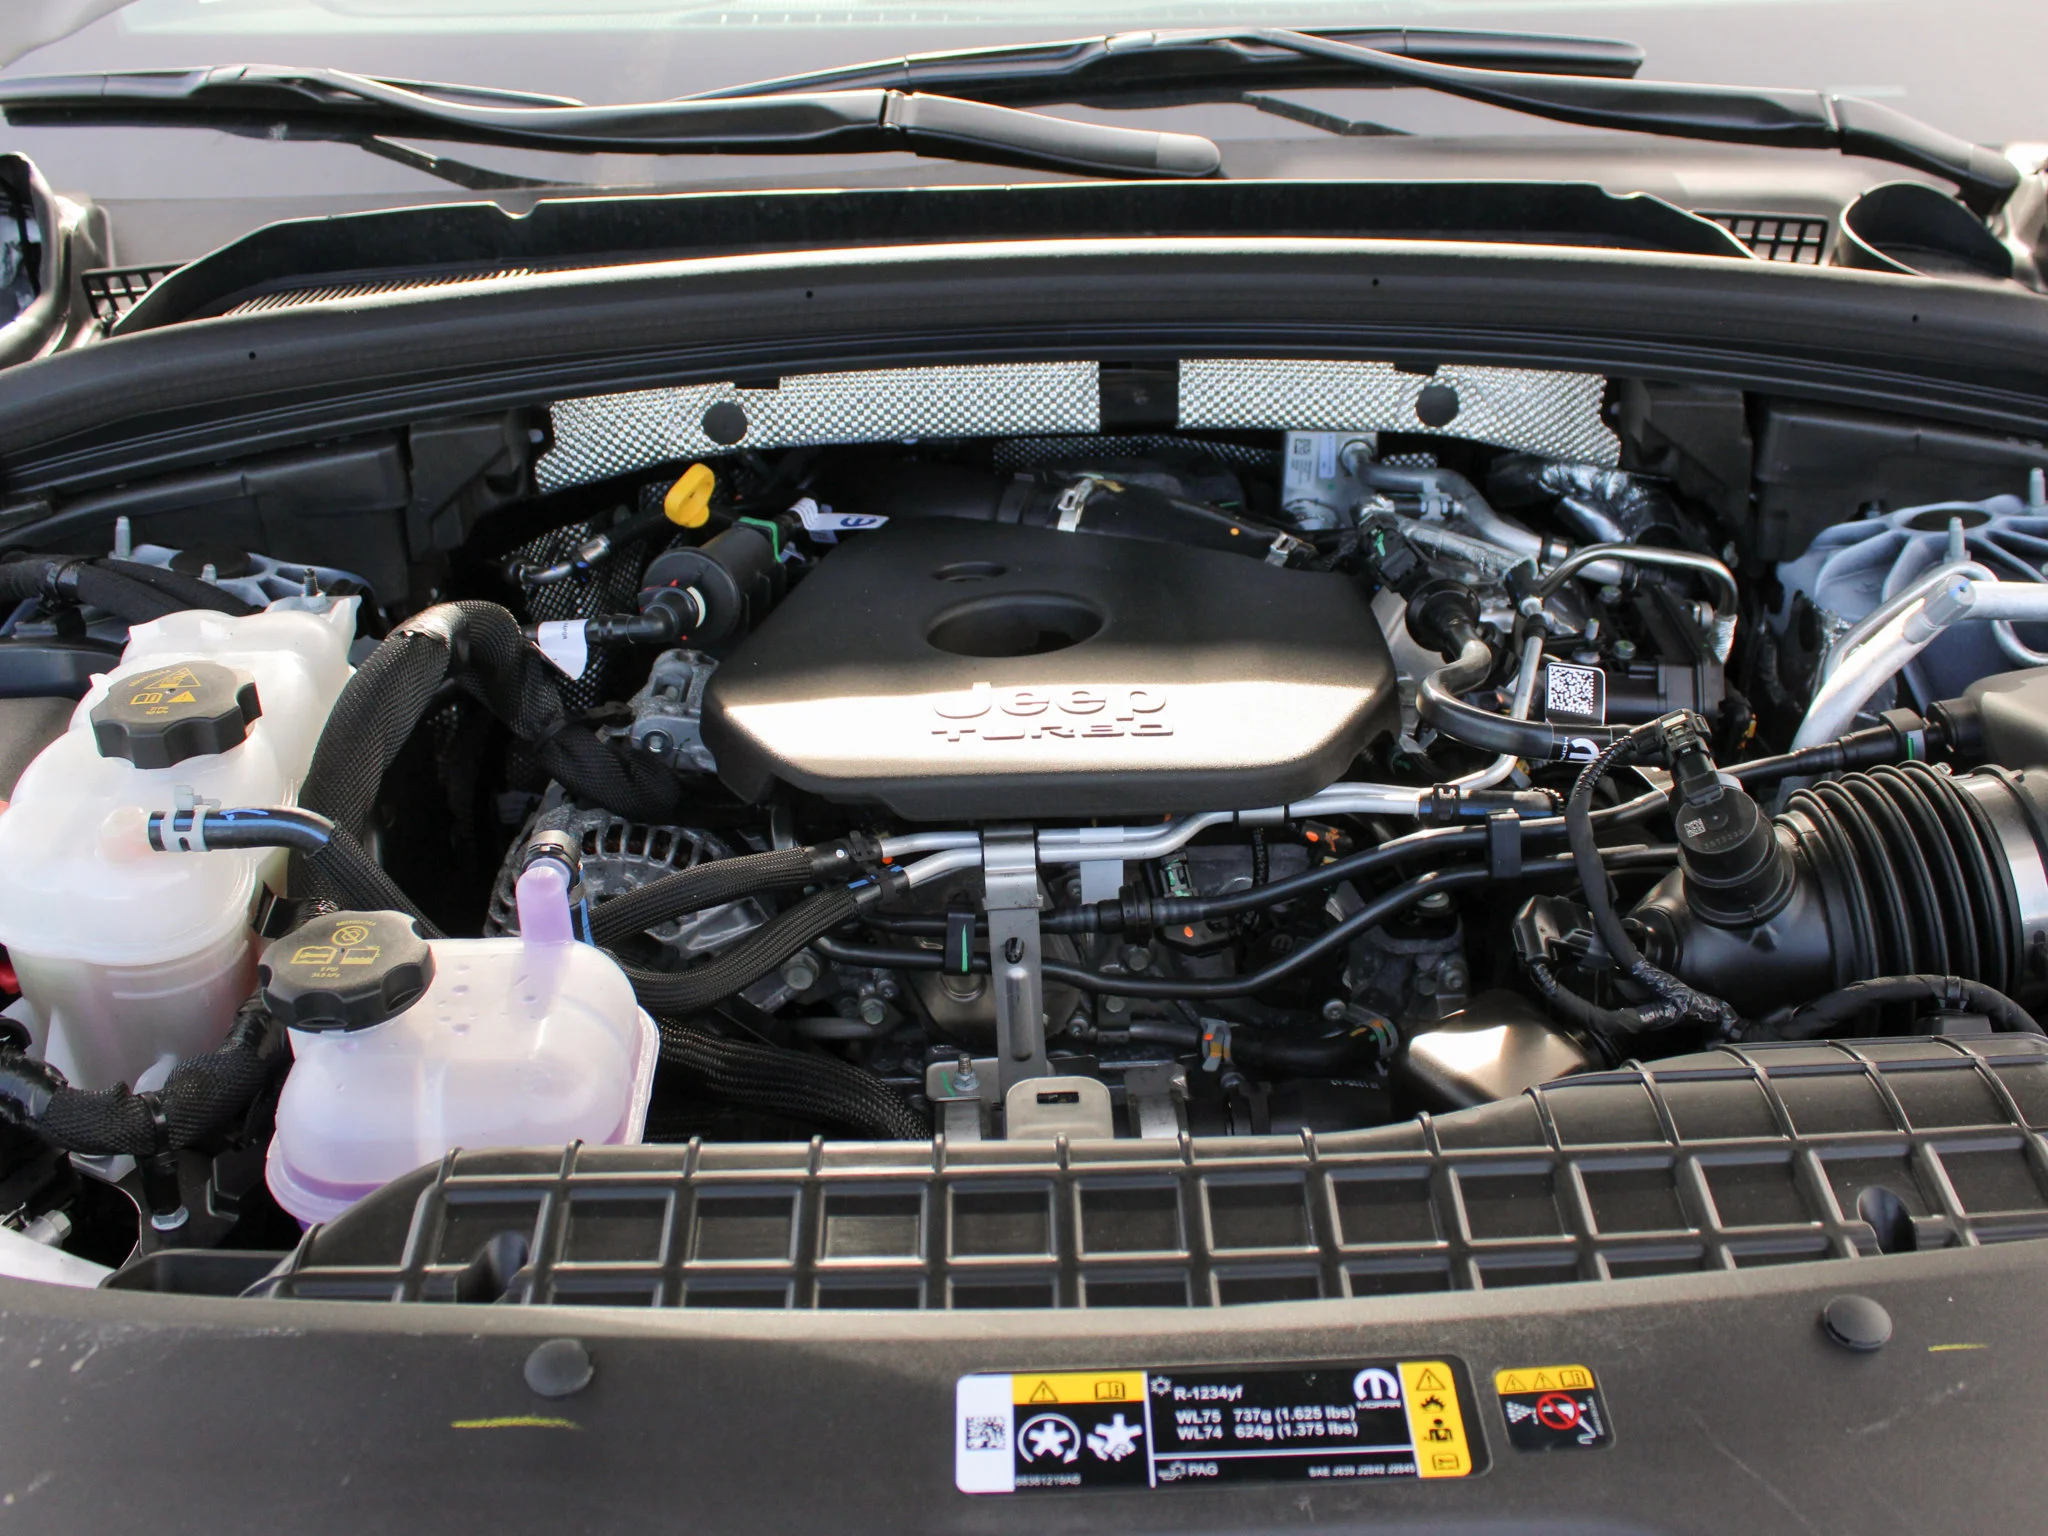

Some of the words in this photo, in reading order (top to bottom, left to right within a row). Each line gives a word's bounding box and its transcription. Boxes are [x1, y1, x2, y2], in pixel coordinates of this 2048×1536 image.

[932, 682, 1167, 721] Jeep
[1173, 1384, 1243, 1402] R-1234yf
[1175, 1408, 1222, 1425] WL75
[1233, 1406, 1272, 1424] 737g
[1275, 1405, 1323, 1424] (1.625
[1324, 1404, 1356, 1421] lbs)
[1177, 1425, 1223, 1441] WL74
[1234, 1423, 1274, 1441] 624g
[1277, 1421, 1325, 1440] (1.375
[1326, 1420, 1358, 1438] lbs)
[1187, 1462, 1218, 1477] PAG
